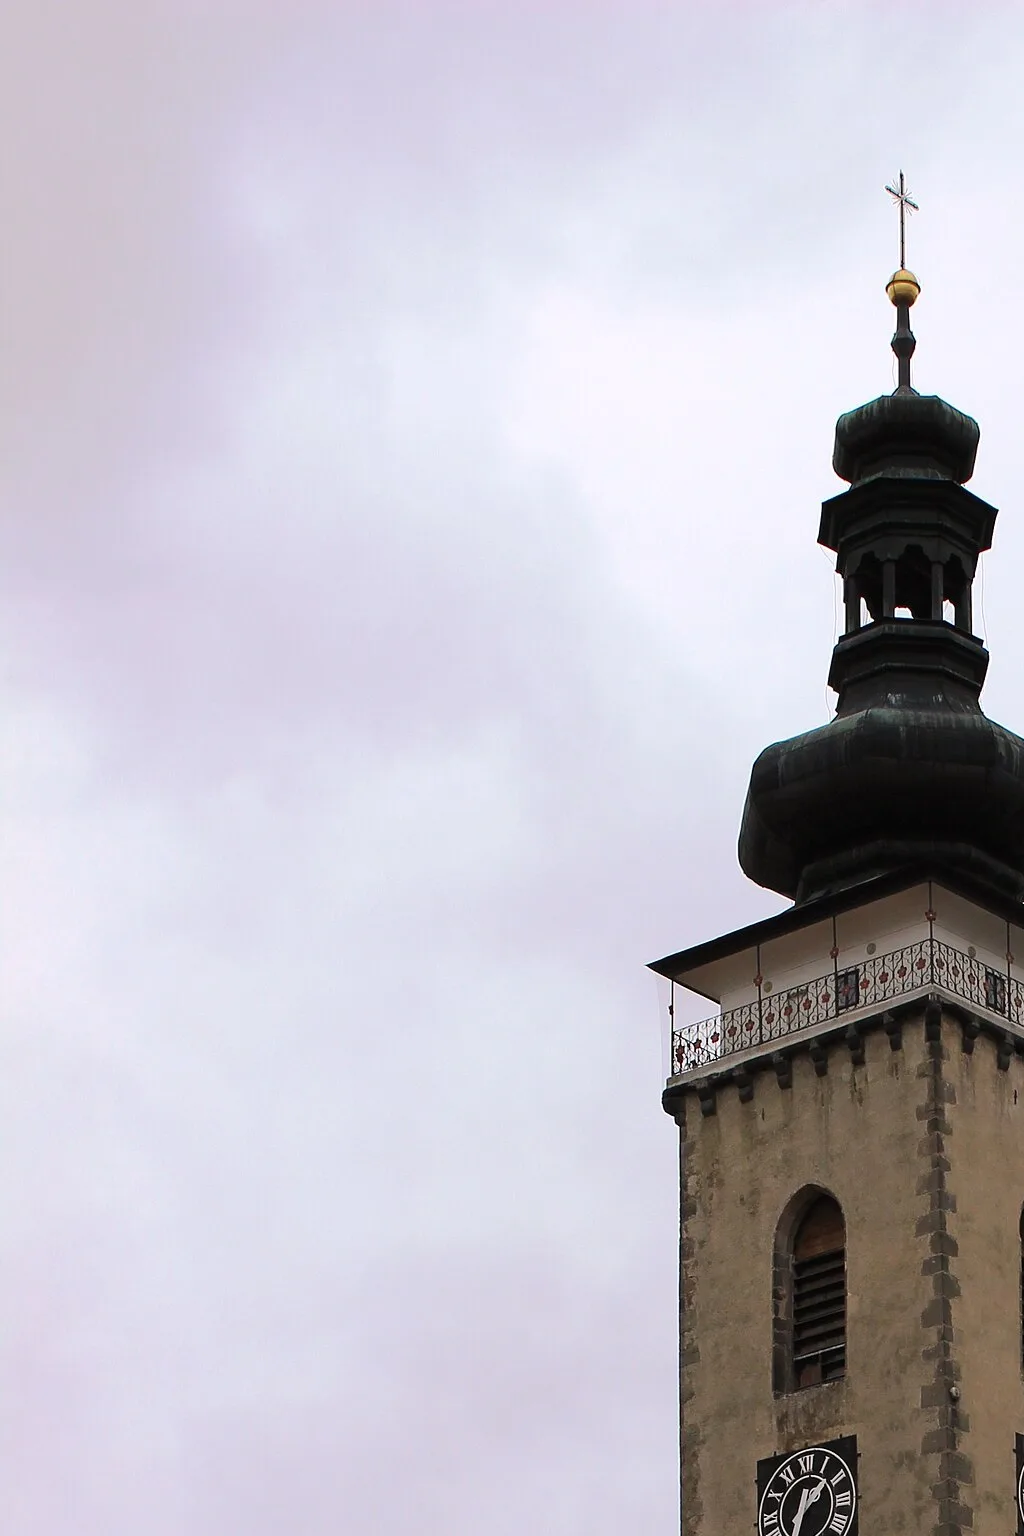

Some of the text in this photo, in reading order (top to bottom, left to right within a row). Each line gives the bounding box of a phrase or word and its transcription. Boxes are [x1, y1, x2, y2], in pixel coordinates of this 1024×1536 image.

[798, 1454, 814, 1474] XII
[820, 1456, 830, 1474] I
[779, 1465, 795, 1487] XI
[830, 1468, 846, 1487] II
[767, 1489, 784, 1503] X
[835, 1490, 851, 1507] III
[763, 1510, 778, 1528] IX
[829, 1512, 849, 1535] IIII
